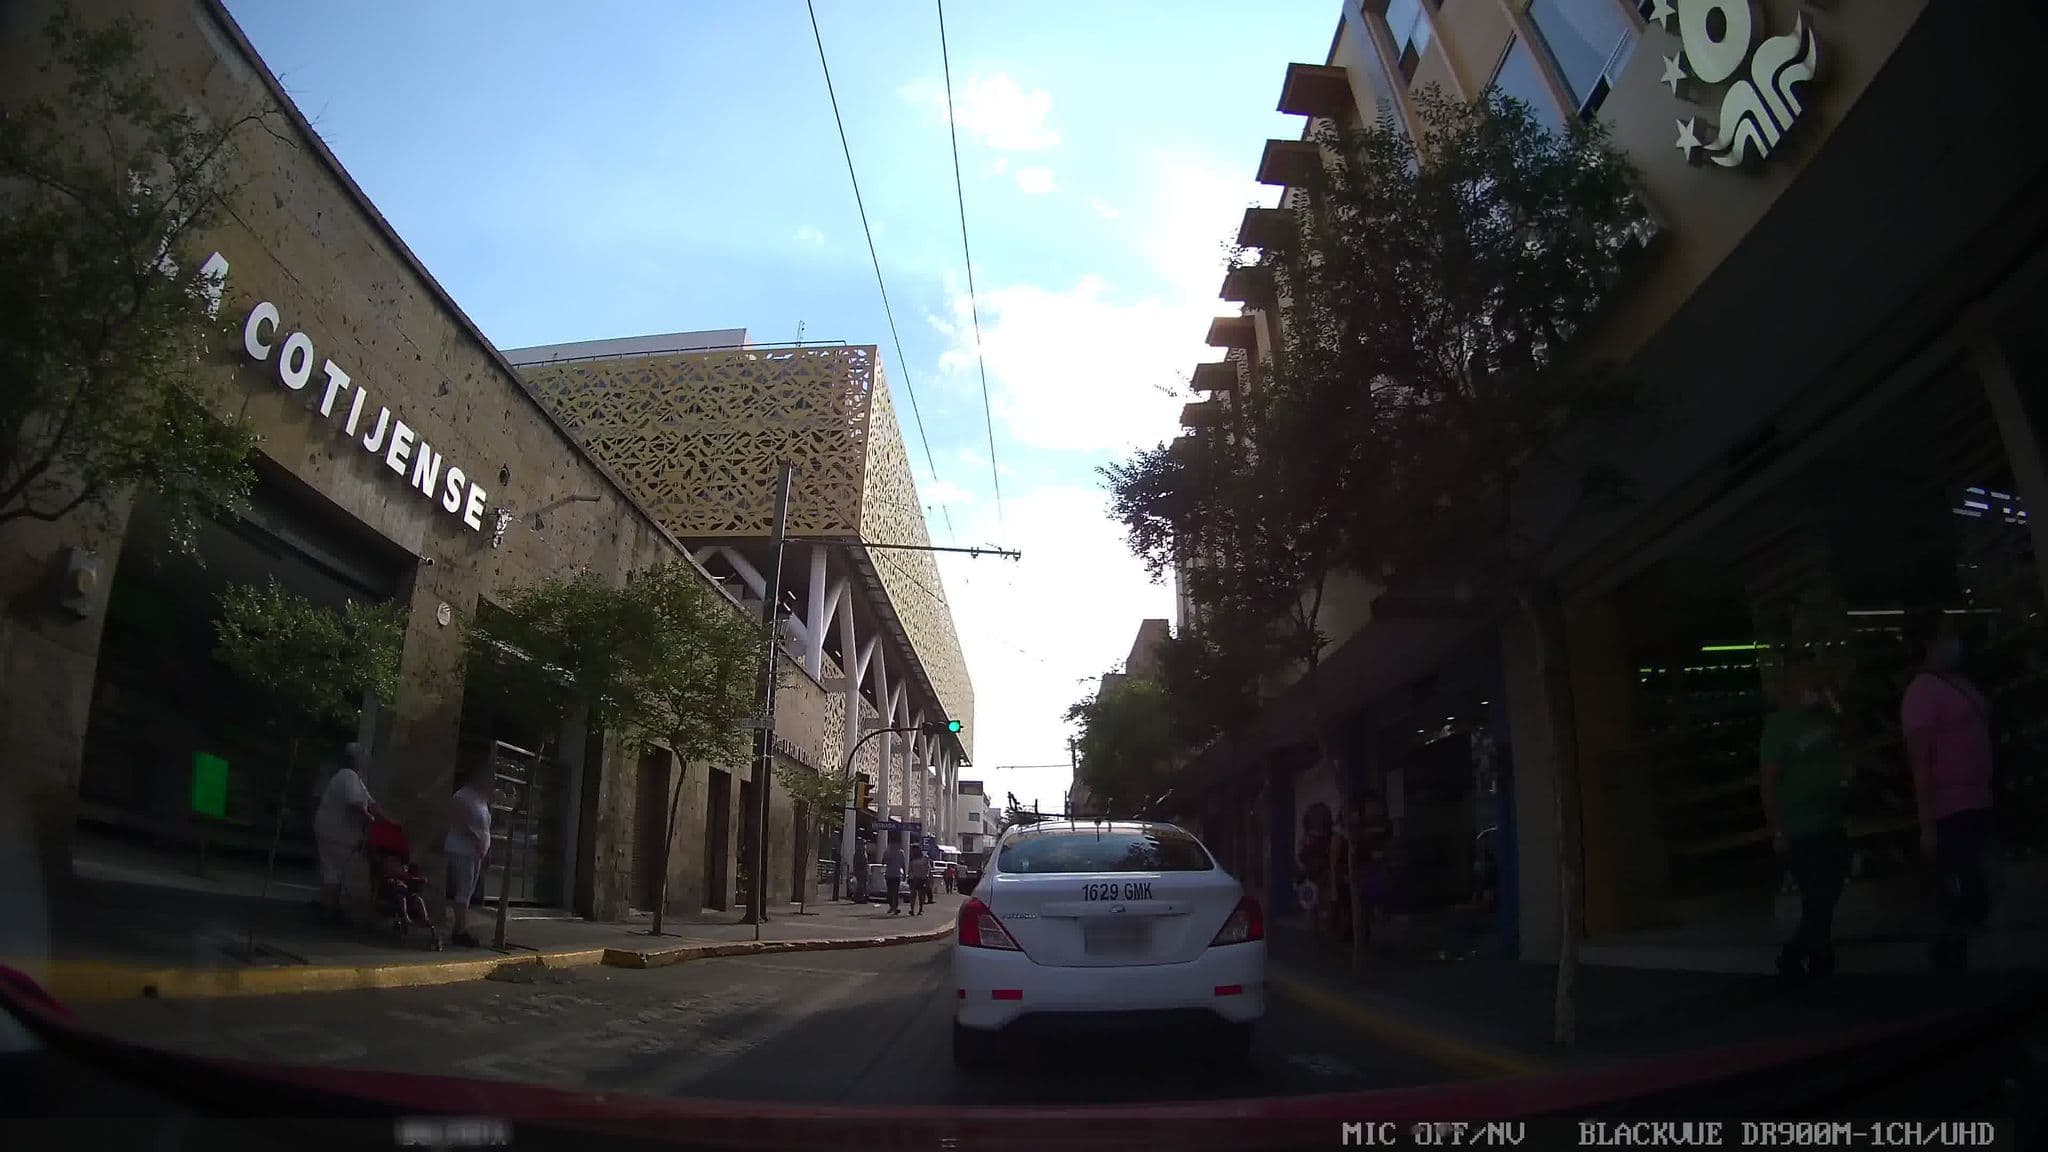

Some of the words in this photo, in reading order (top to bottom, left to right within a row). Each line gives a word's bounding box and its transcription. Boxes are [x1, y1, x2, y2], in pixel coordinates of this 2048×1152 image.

[243, 300, 488, 532] COTIJENSE
[1082, 883, 1119, 901] 1629
[1124, 882, 1153, 901] GMK
